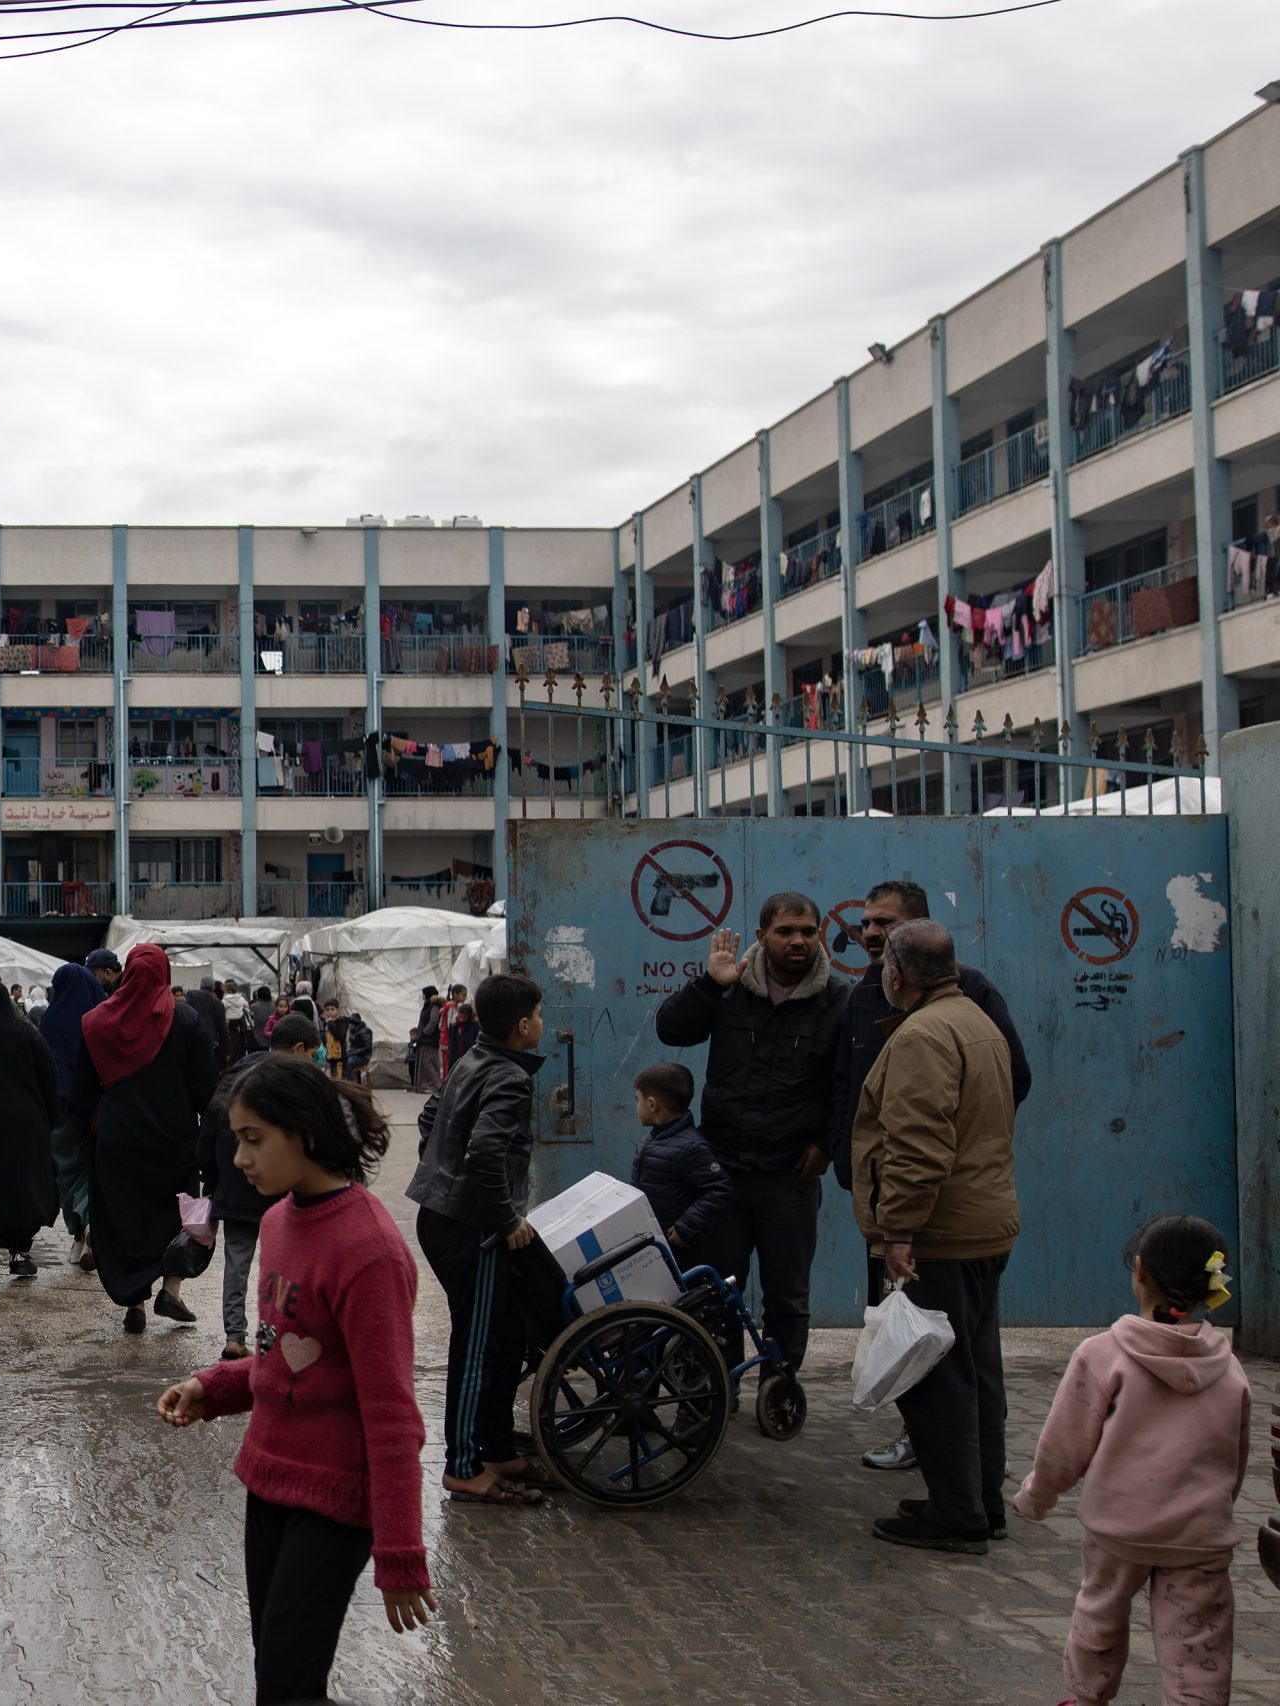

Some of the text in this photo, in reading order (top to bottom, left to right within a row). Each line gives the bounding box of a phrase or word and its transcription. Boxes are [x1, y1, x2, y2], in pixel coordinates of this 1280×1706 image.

[32, 805, 66, 822] خولة
[68, 805, 111, 822] مدرسة
[643, 961, 676, 977] NO
[617, 1261, 633, 1275] Food
[620, 1272, 633, 1283] Box
